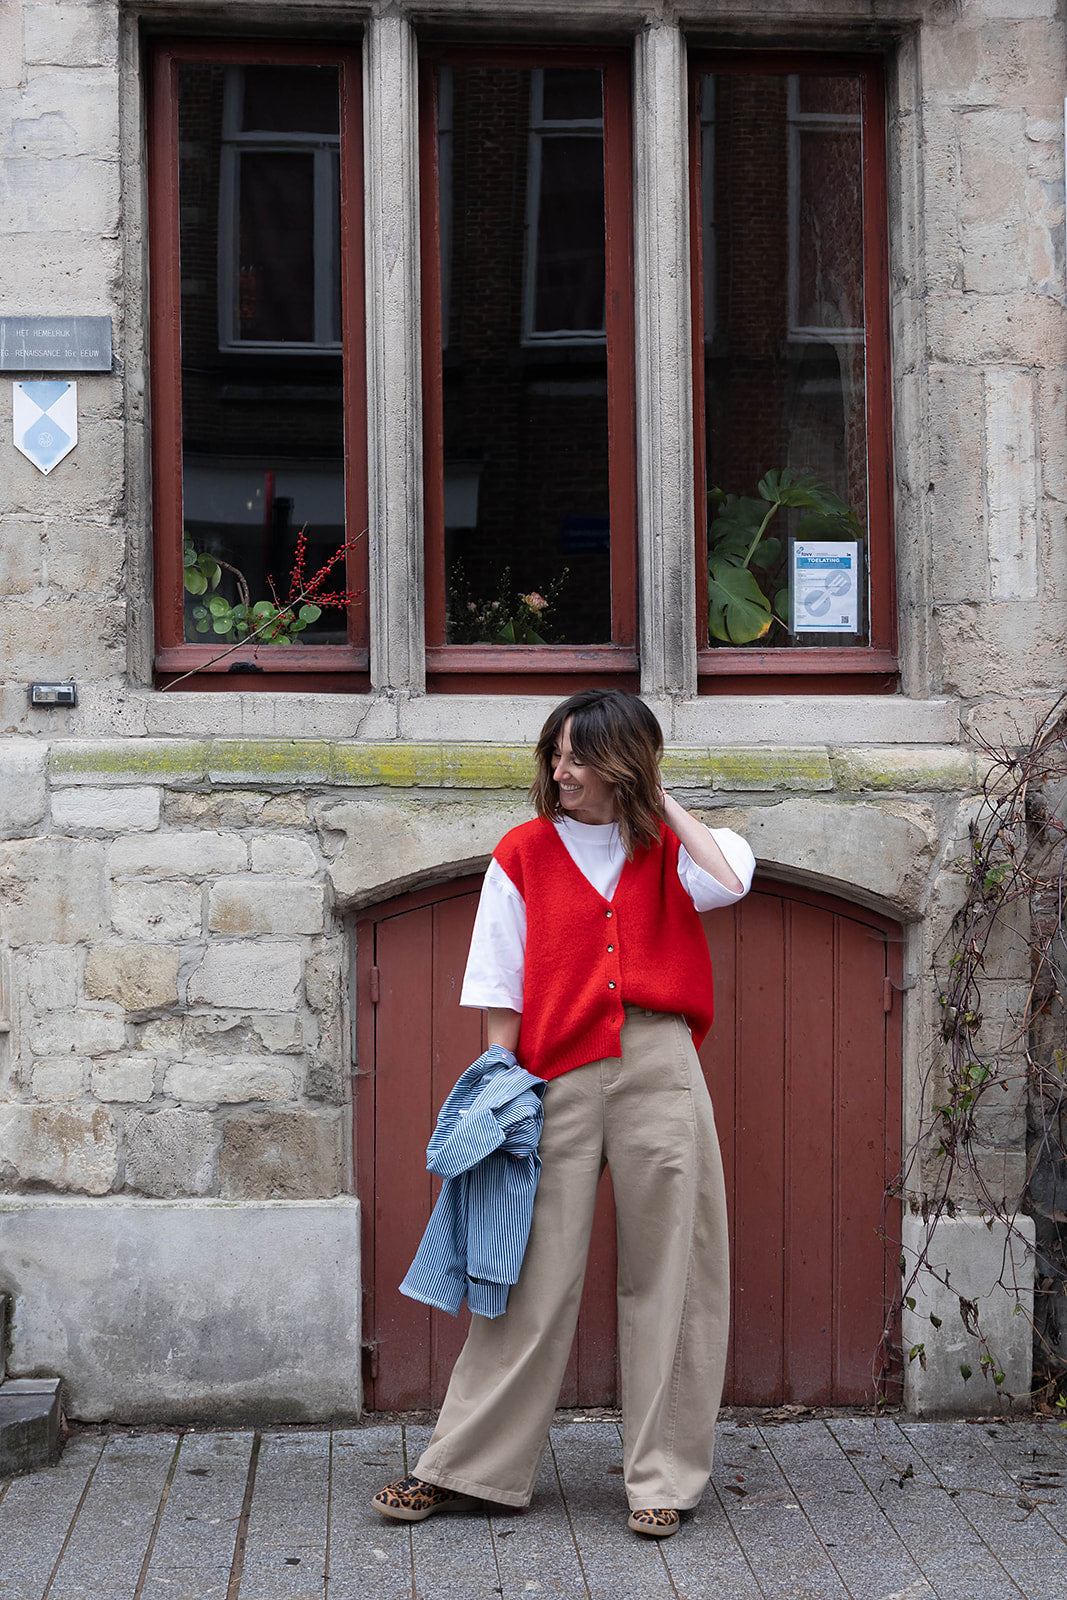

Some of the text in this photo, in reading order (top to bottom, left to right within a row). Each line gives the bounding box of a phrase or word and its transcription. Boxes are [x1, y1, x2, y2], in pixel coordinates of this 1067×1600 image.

[16, 329, 71, 337] HET HEMELRIJK
[80, 349, 100, 357] EEUW
